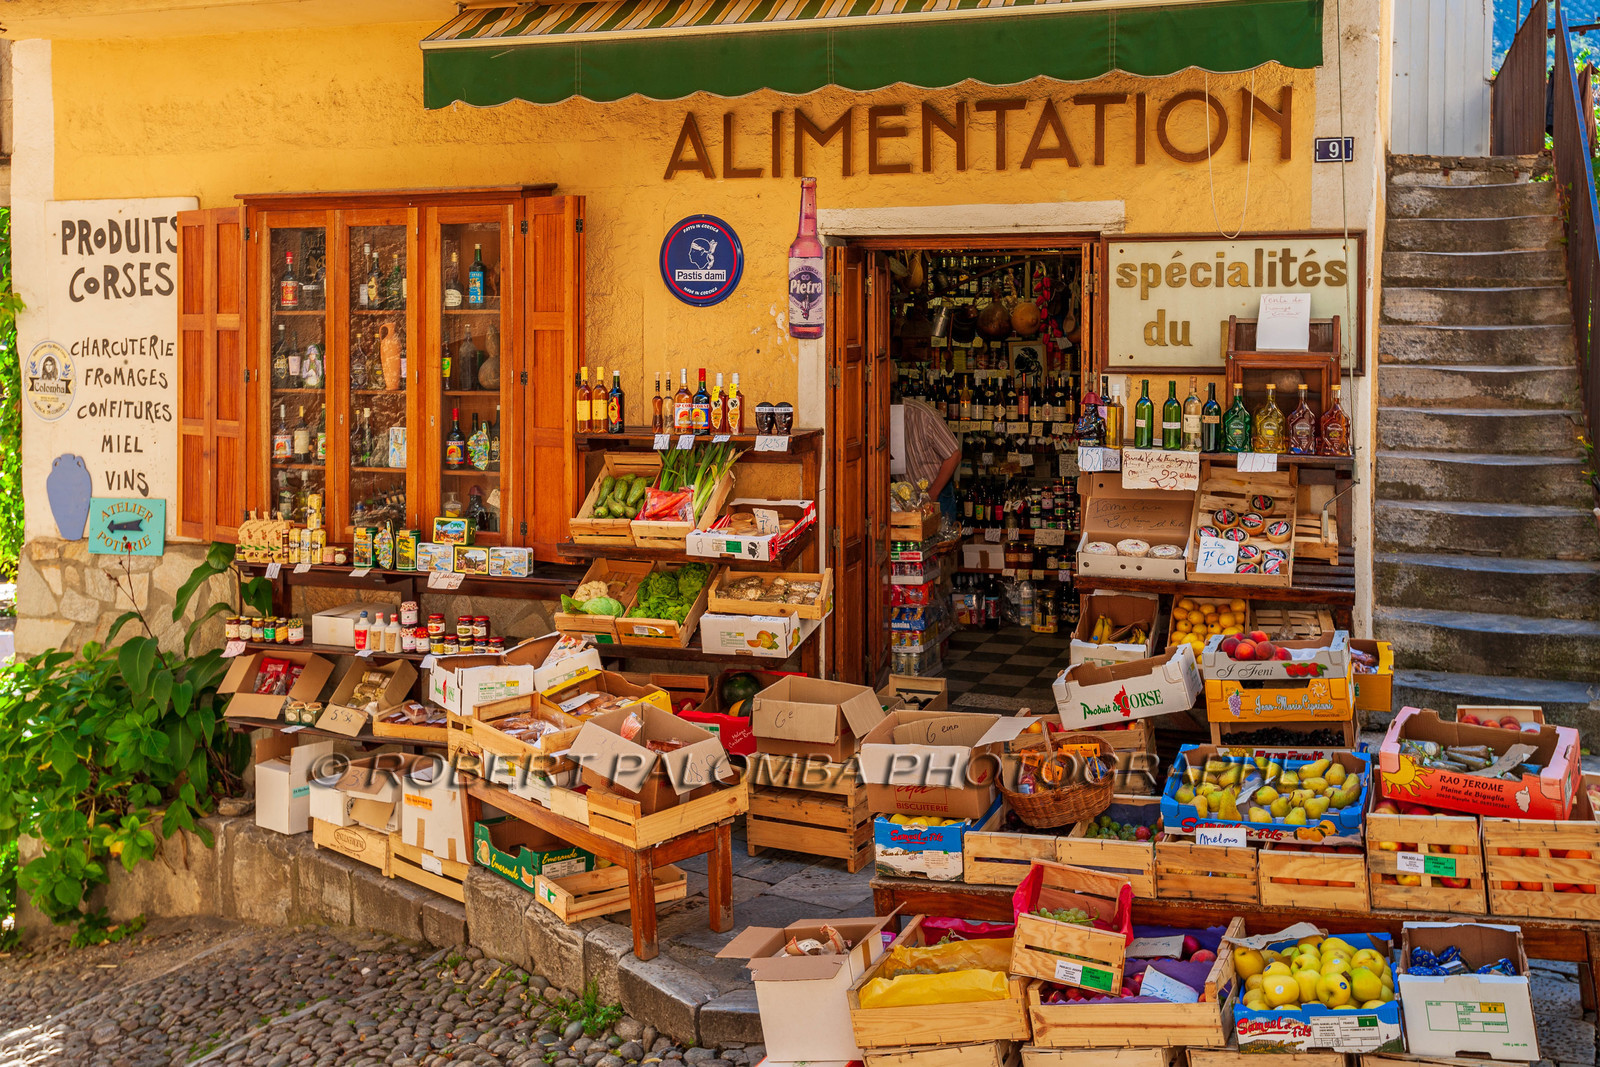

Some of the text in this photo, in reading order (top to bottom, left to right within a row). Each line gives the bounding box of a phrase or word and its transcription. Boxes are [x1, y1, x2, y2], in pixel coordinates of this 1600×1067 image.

[664, 85, 1292, 179] ALIMENTATION
[1328, 142, 1340, 158] 9
[69, 262, 174, 302] CORSES
[677, 271, 725, 280] Pastis dami
[1116, 248, 1348, 300] spécialités
[790, 279, 822, 294] Pietra
[1143, 309, 1193, 347] du
[70, 335, 174, 360] CHARCUTERIE
[34, 382, 65, 394] Colomba
[85, 367, 168, 389] FROMAGES
[77, 398, 172, 423] CONFITURES
[101, 435, 143, 453] MIEL
[105, 469, 149, 497] VINS
[1149, 469, 1178, 490] 23
[101, 501, 153, 523] ATELIER
[1080, 689, 1164, 720] Produit de CORSE
[926, 721, 936, 743] 6
[1439, 775, 1504, 793] RAO JEROME
[1440, 785, 1462, 795] Plaine
[896, 803, 949, 812] BISCUITERIE
[890, 829, 922, 842] Samuel
[929, 833, 944, 842] Fils
[1257, 828, 1284, 841] Fils
[490, 853, 520, 881] Emeraude
[541, 848, 578, 865] Emeraude
[1236, 1015, 1292, 1036] Samuel et
[1291, 1025, 1312, 1038] Fils
